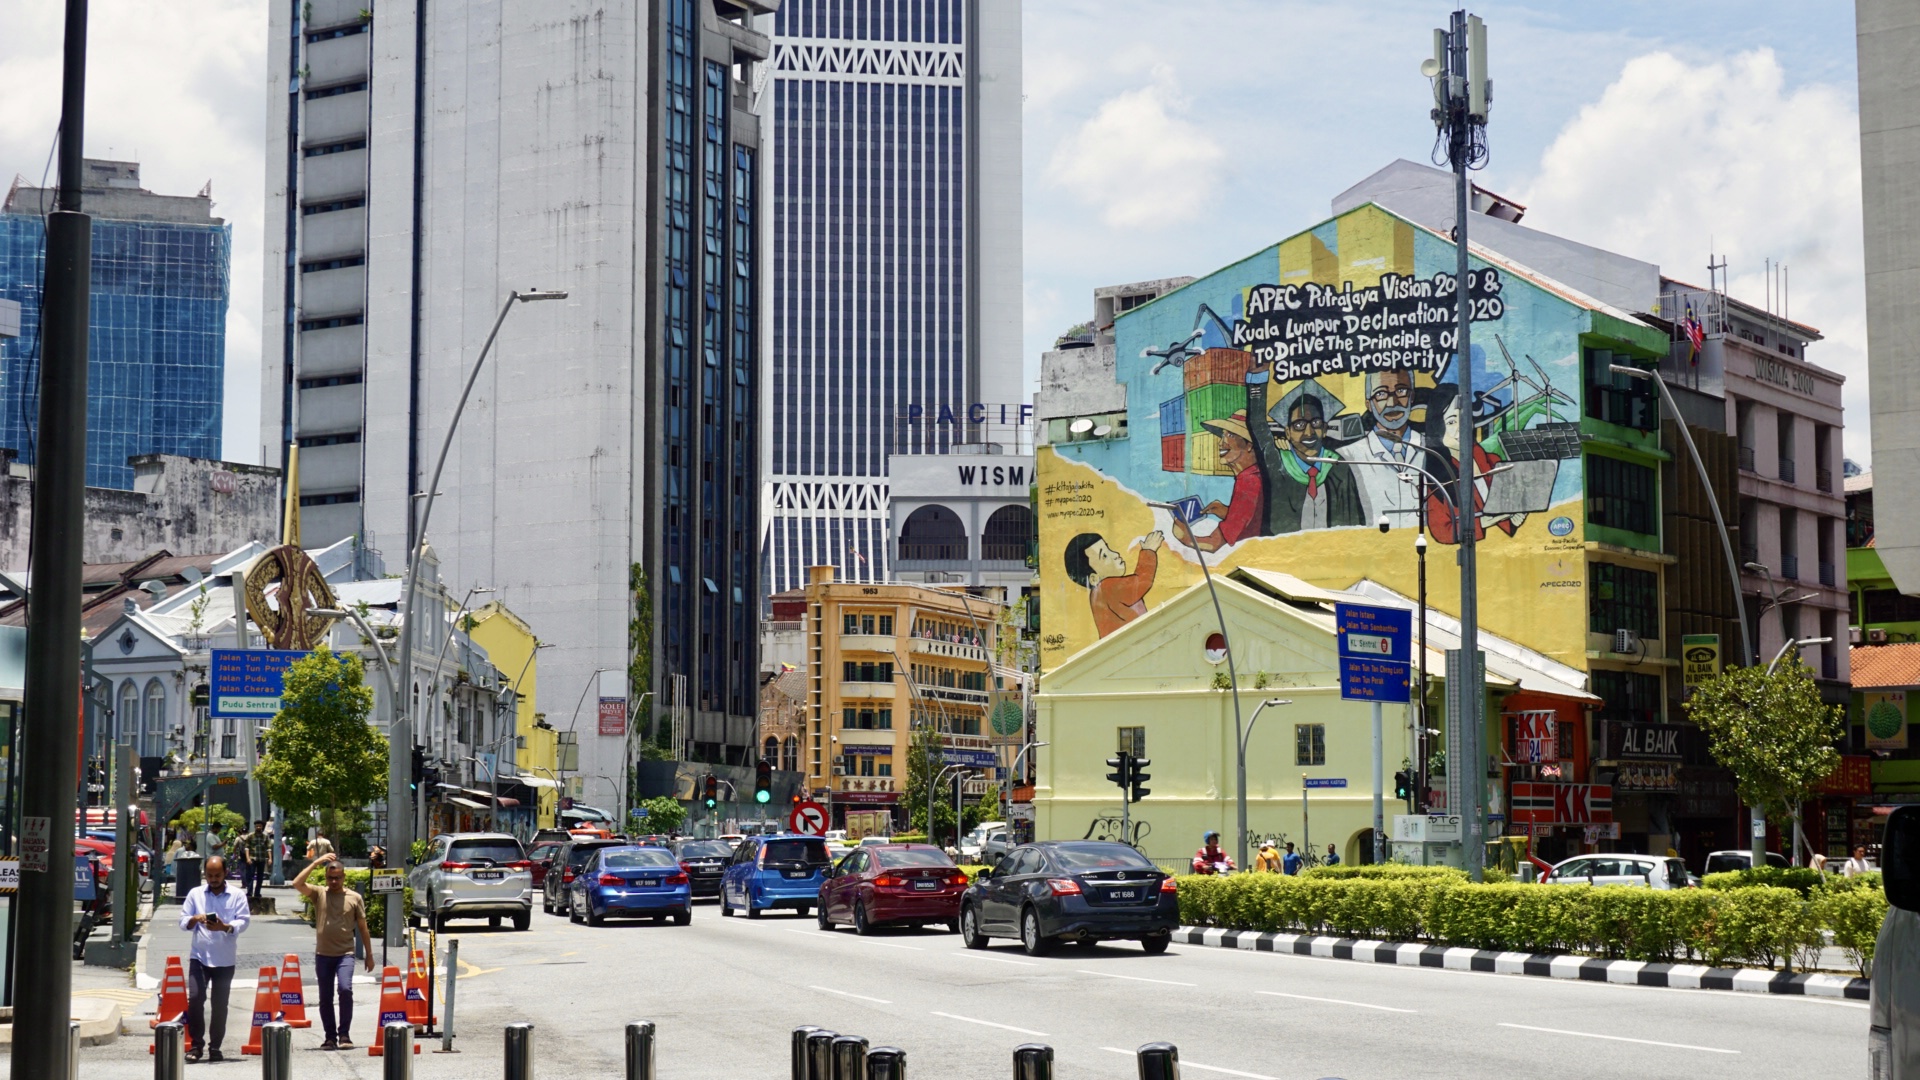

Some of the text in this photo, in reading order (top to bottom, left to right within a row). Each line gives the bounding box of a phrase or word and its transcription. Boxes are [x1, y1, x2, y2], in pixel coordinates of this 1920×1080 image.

[1249, 271, 1500, 315] APEC Putrajaya Vision 200 &
[1234, 320, 1280, 344] Kuala
[1286, 318, 1341, 339] Lumpur
[1343, 302, 1448, 334] Declaration
[1276, 353, 1344, 380] Shared
[1755, 358, 1814, 396] WISMA 2000
[214, 474, 236, 490] KYH
[1360, 611, 1376, 619] Istana
[1360, 640, 1377, 648] Sentral
[1688, 664, 1713, 673] AL BAIK
[1519, 713, 1551, 738] KK
[1517, 741, 1530, 761] BUKA
[1530, 740, 1540, 762] 24
[1622, 728, 1678, 754] AL BAIK
[1555, 784, 1590, 823] KK
